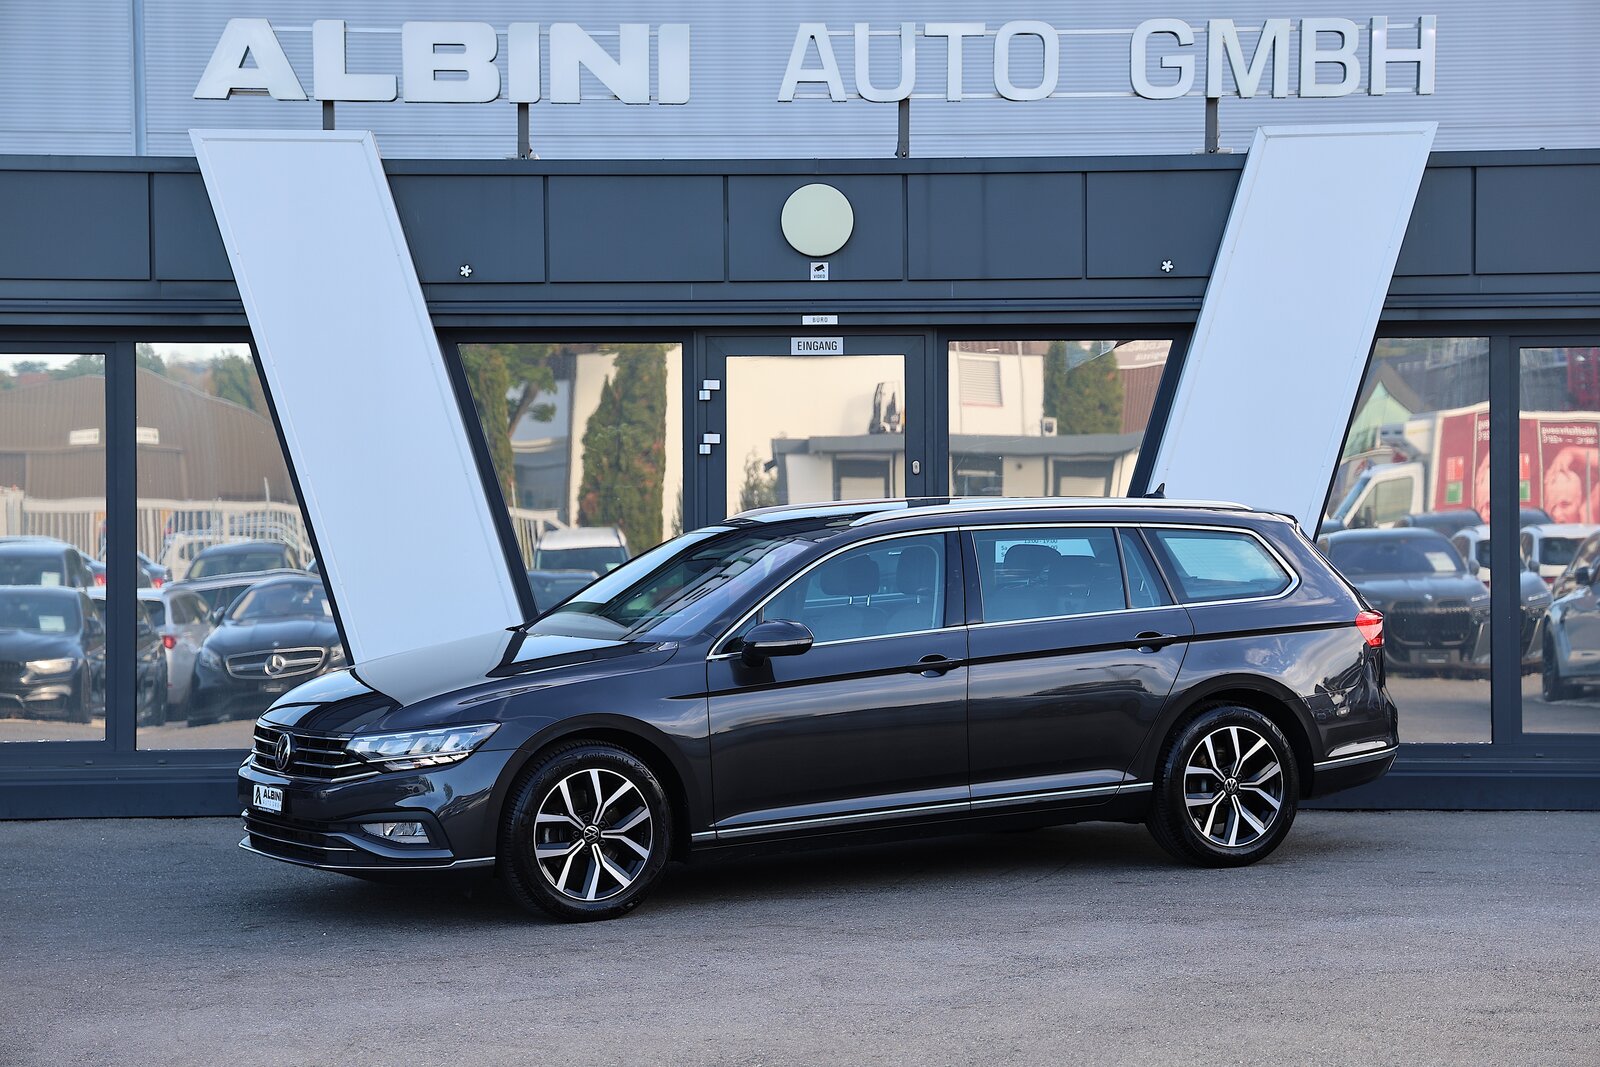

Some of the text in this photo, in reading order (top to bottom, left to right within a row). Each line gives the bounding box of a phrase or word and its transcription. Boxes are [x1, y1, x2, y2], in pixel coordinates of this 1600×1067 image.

[193, 15, 1437, 104] ALBINI AUTO GMBH
[797, 341, 838, 351] EINGANG
